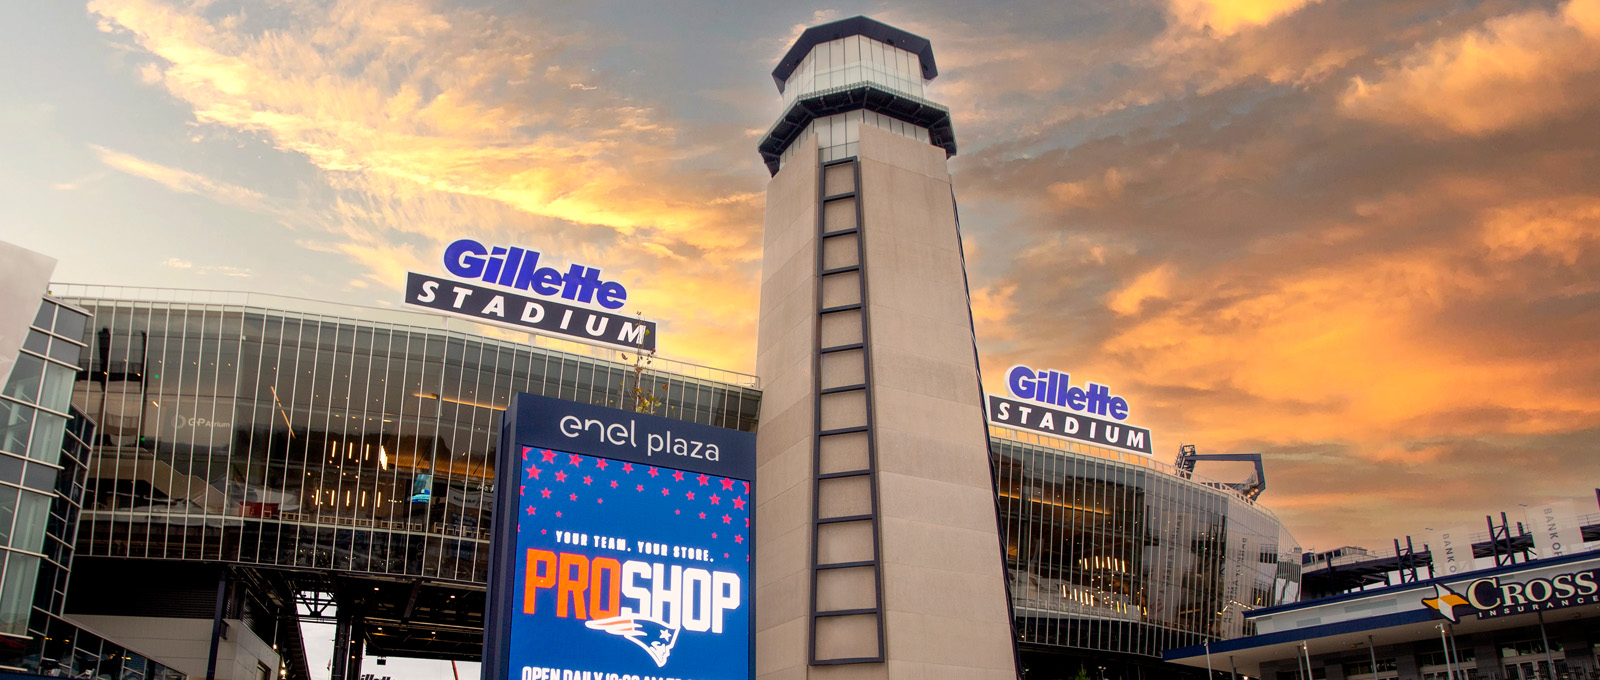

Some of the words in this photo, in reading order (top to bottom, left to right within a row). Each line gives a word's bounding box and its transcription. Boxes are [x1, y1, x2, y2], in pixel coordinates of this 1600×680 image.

[444, 239, 627, 309] Gillette
[417, 280, 647, 345] STADIUM
[1009, 366, 1129, 420] Gillette
[205, 420, 231, 428] Arium
[559, 415, 637, 448] enel
[647, 430, 720, 462] plaza
[997, 402, 1144, 449] STADIUM
[555, 530, 588, 547] YOUR
[593, 535, 632, 552] TEAM.
[637, 541, 668, 557] YOUR
[672, 545, 714, 563] STORE.
[1478, 595, 1600, 618] INSURANCE
[521, 666, 561, 680] OPEN
